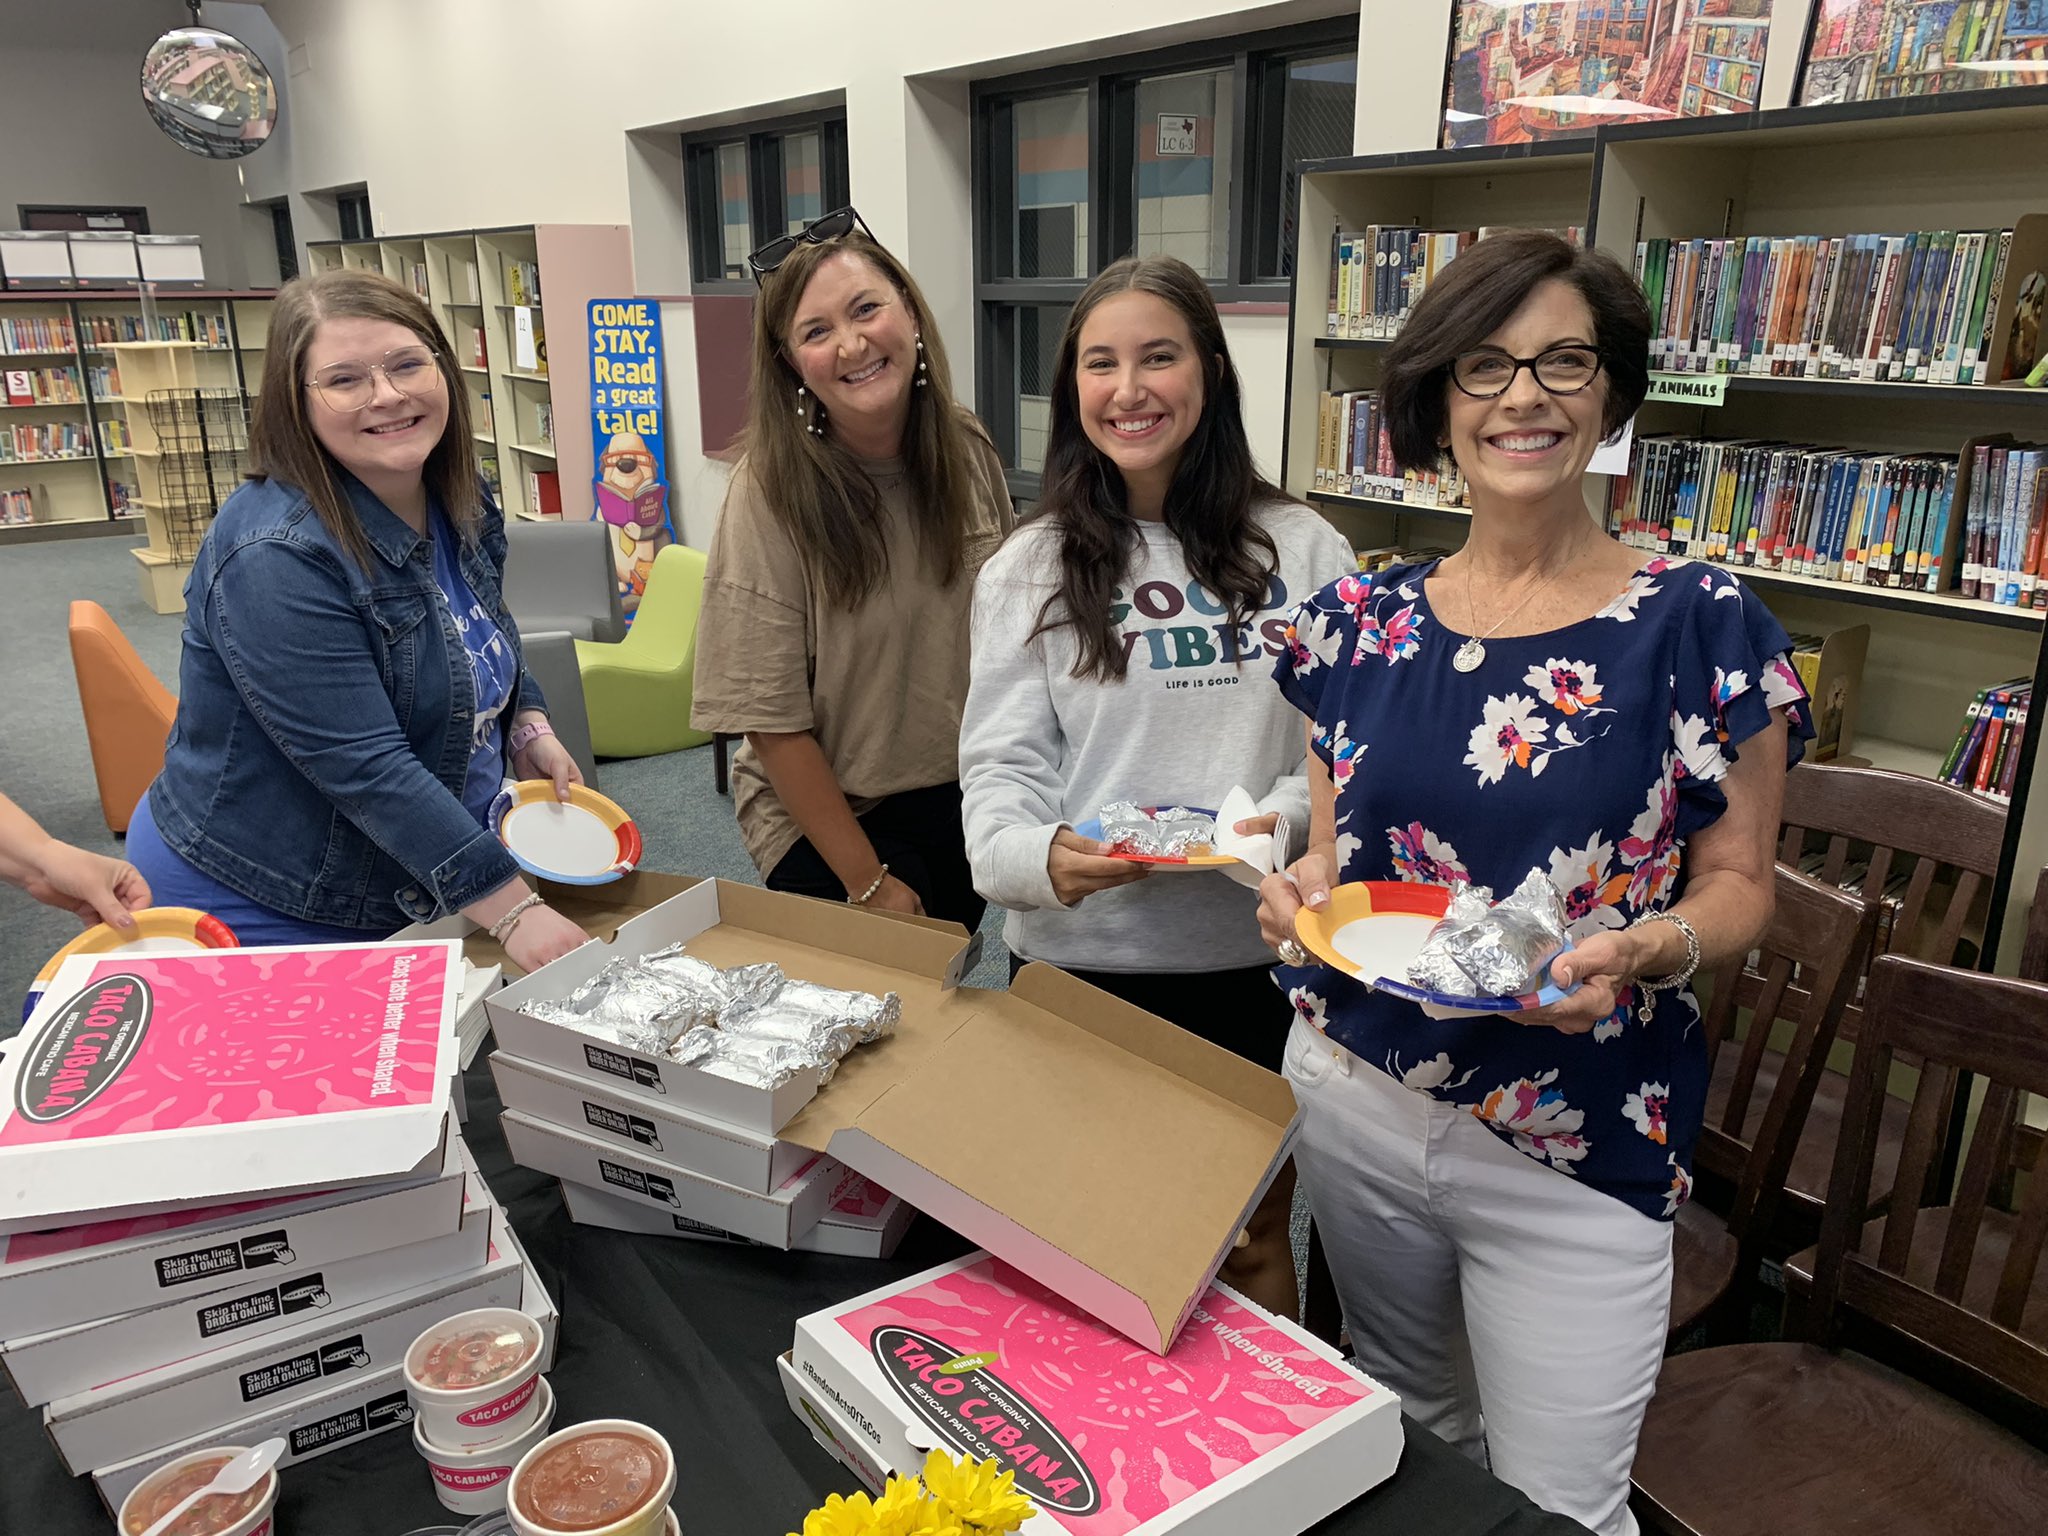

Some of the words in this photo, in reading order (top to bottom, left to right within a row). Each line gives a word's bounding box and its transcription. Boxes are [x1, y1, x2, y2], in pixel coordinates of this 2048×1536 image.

[1163, 138, 1176, 150] LC
[1179, 138, 1193, 150] 6-3
[519, 318, 526, 331] 12
[592, 304, 654, 326] COME.
[594, 329, 656, 354] STAY.
[14, 373, 24, 386] S
[594, 356, 656, 384] Read
[596, 389, 606, 404] a
[611, 388, 656, 406] great
[1658, 381, 1717, 398] ANIMALS
[597, 410, 658, 435] tale!
[1208, 677, 1239, 686] GOOD
[392, 954, 417, 978] Tacos
[388, 978, 410, 1002] taste
[84, 984, 134, 1027] TACO
[382, 1002, 410, 1030] better
[57, 1012, 80, 1040] MEXICAN
[121, 1019, 134, 1032] THE
[47, 1040, 64, 1062] PATIO
[104, 1032, 130, 1062] ORIGINAL
[377, 1030, 402, 1059] when
[36, 1060, 54, 1077] CAFE
[38, 1032, 110, 1108] CABANA
[370, 1058, 400, 1098] shared.
[162, 1256, 188, 1270] Skip
[190, 1252, 209, 1264] the
[211, 1248, 235, 1260] line.
[164, 1264, 198, 1279] ORDER
[200, 1255, 236, 1272] ONLINE
[204, 1307, 228, 1320] Skip
[231, 1300, 249, 1312] the
[251, 1294, 274, 1306] line.
[205, 1312, 238, 1329] ORDER
[240, 1301, 276, 1319] ONLINE
[246, 1370, 271, 1385] Skip
[272, 1364, 290, 1376] the
[292, 1357, 315, 1370] line.
[953, 1357, 984, 1370] Potato
[1212, 1322, 1262, 1358] when
[1258, 1353, 1328, 1400] shared.
[247, 1376, 280, 1393] ORDER
[281, 1363, 316, 1382] ONLINE
[470, 1407, 499, 1423] TACO
[502, 1382, 535, 1411] CABANA
[803, 1361, 881, 1444] #RandomActsOfTaCos
[971, 1376, 990, 1394] THE
[988, 1392, 1031, 1430] ORIGINAL
[296, 1426, 318, 1440] Skip
[321, 1418, 337, 1431] the
[339, 1412, 360, 1425] line.
[894, 1338, 964, 1396] TACO
[959, 1399, 1081, 1499] CABANA
[910, 1383, 951, 1419] MEXICAN
[948, 1418, 976, 1442] PATIO
[975, 1441, 1004, 1466] CAFE
[296, 1431, 327, 1448] ORDER
[329, 1417, 361, 1436] ONLINE
[454, 1472, 498, 1485] CABANA
